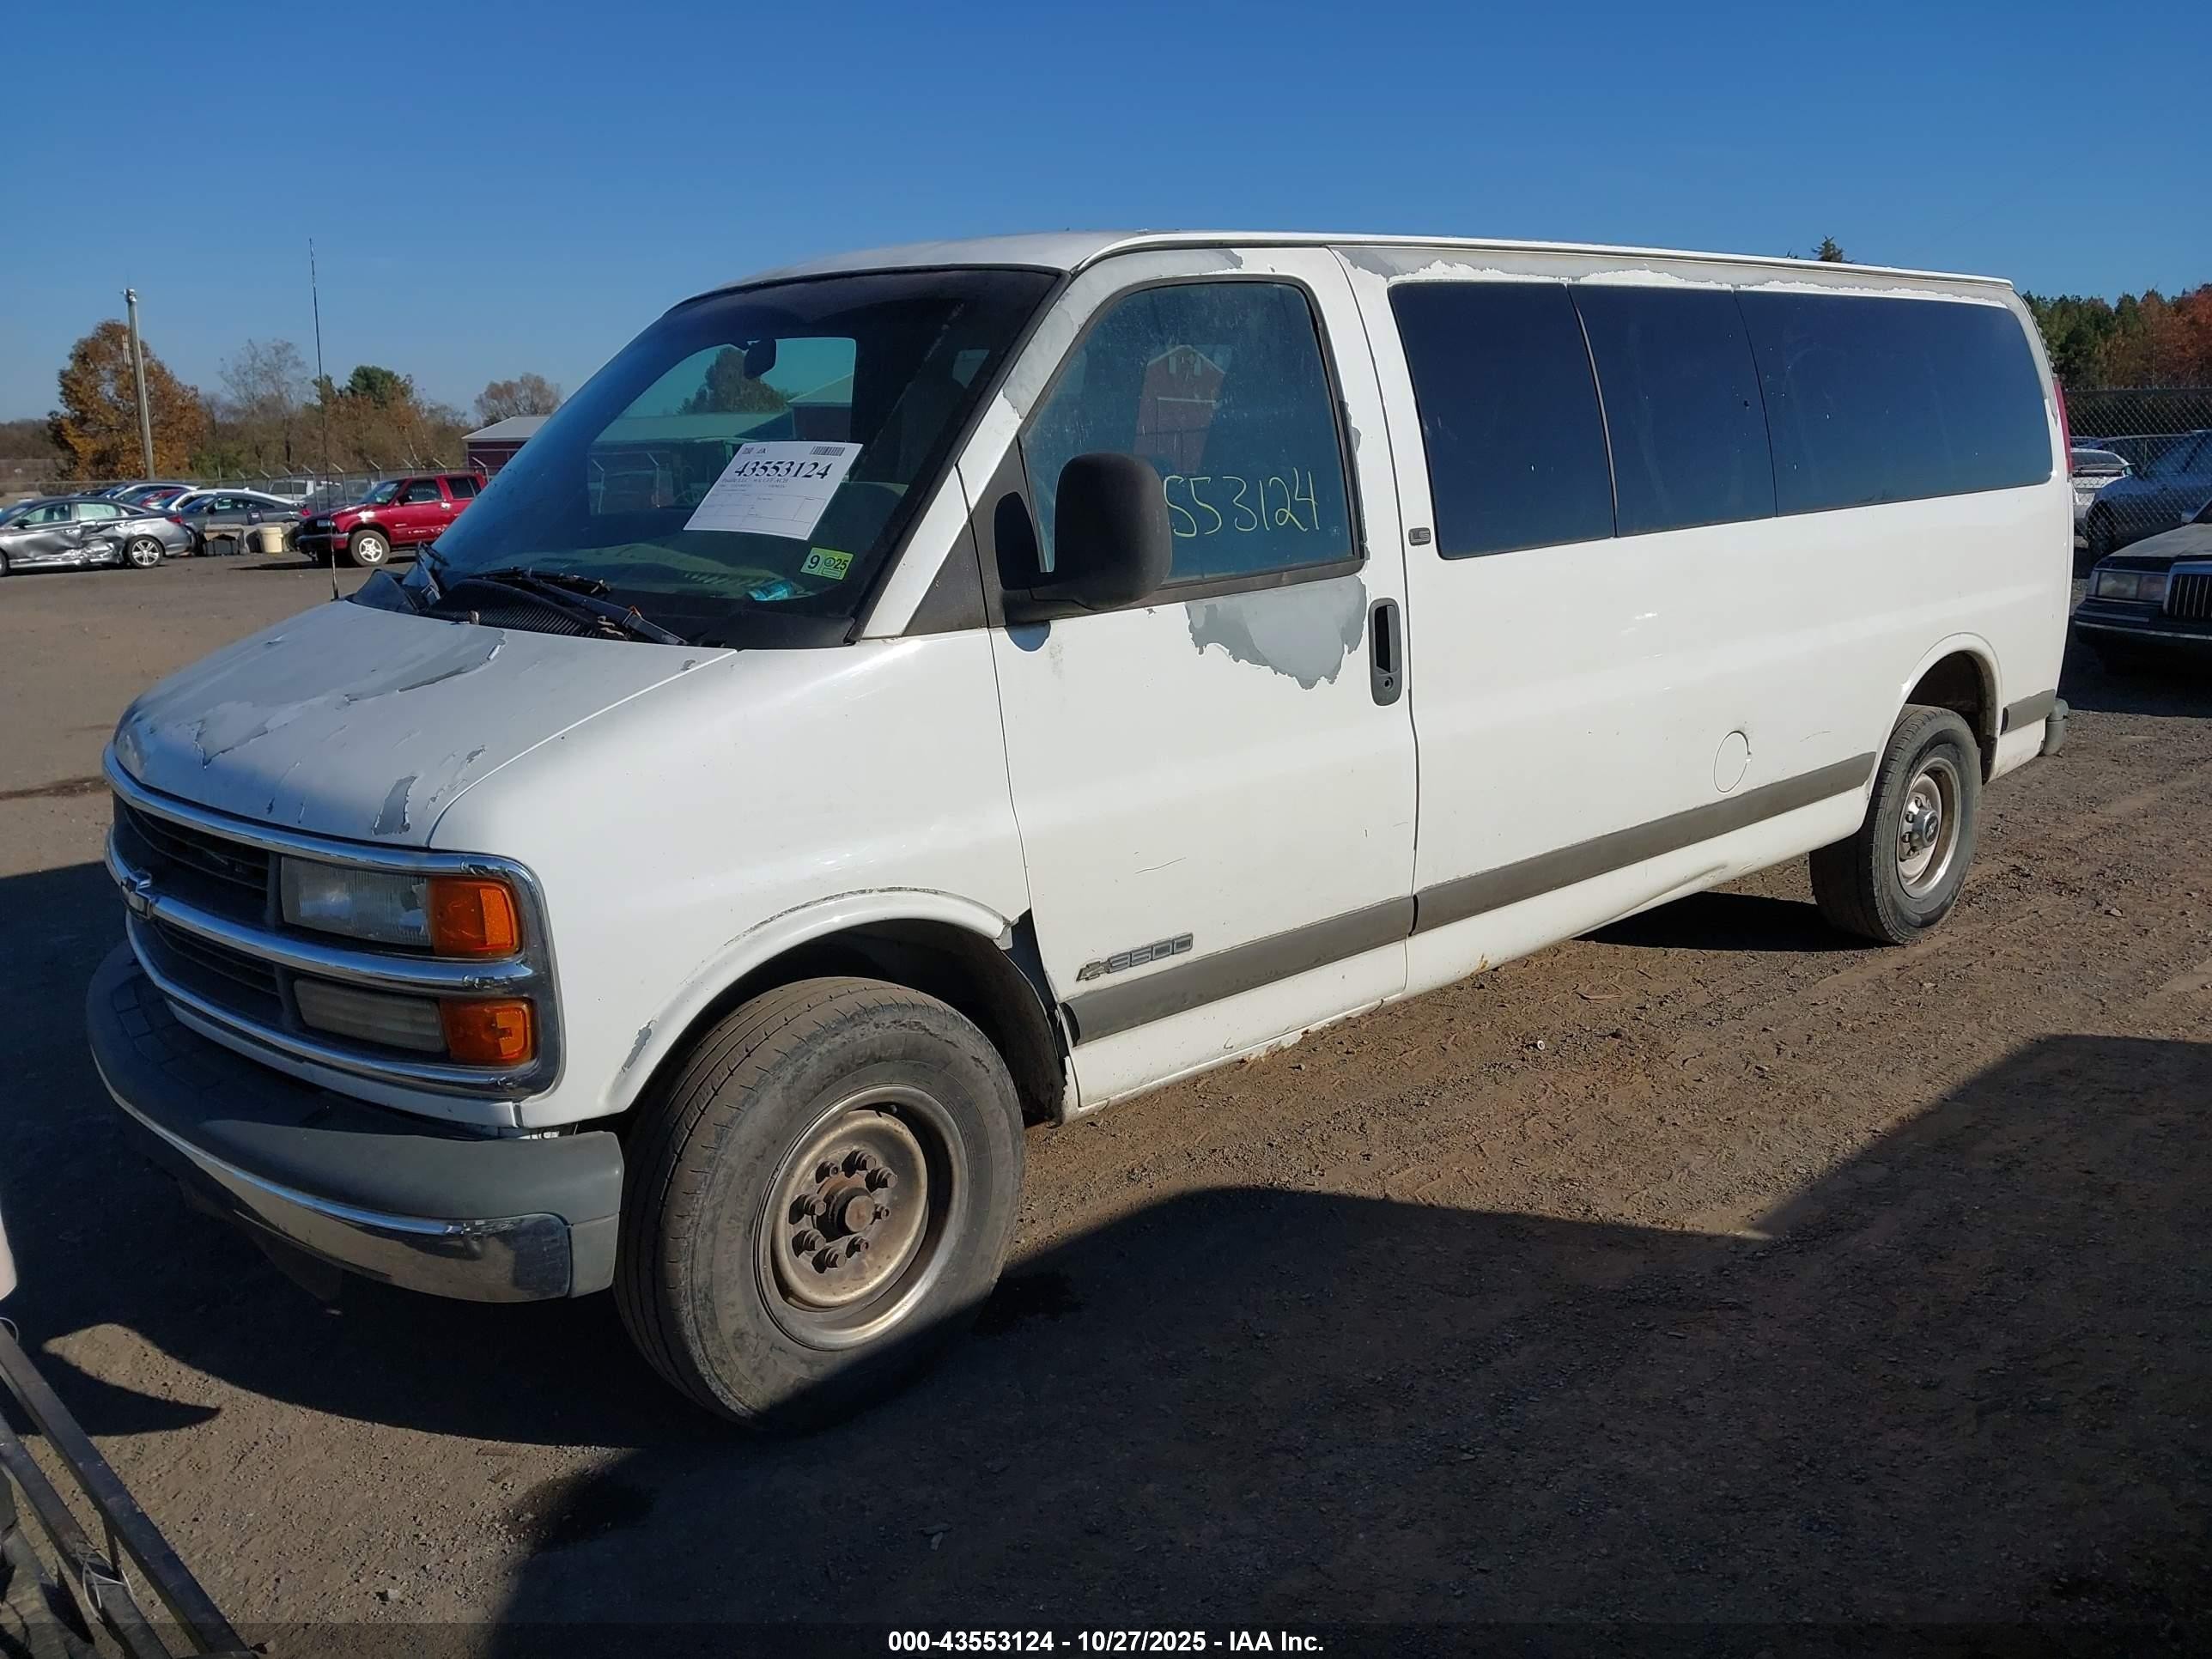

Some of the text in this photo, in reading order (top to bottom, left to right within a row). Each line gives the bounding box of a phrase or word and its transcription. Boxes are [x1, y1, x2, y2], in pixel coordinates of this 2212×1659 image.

[734, 460, 833, 479] 43553124
[1410, 530, 1431, 544] LS
[807, 555, 849, 571] 9 25
[1108, 932, 1194, 974] 3500
